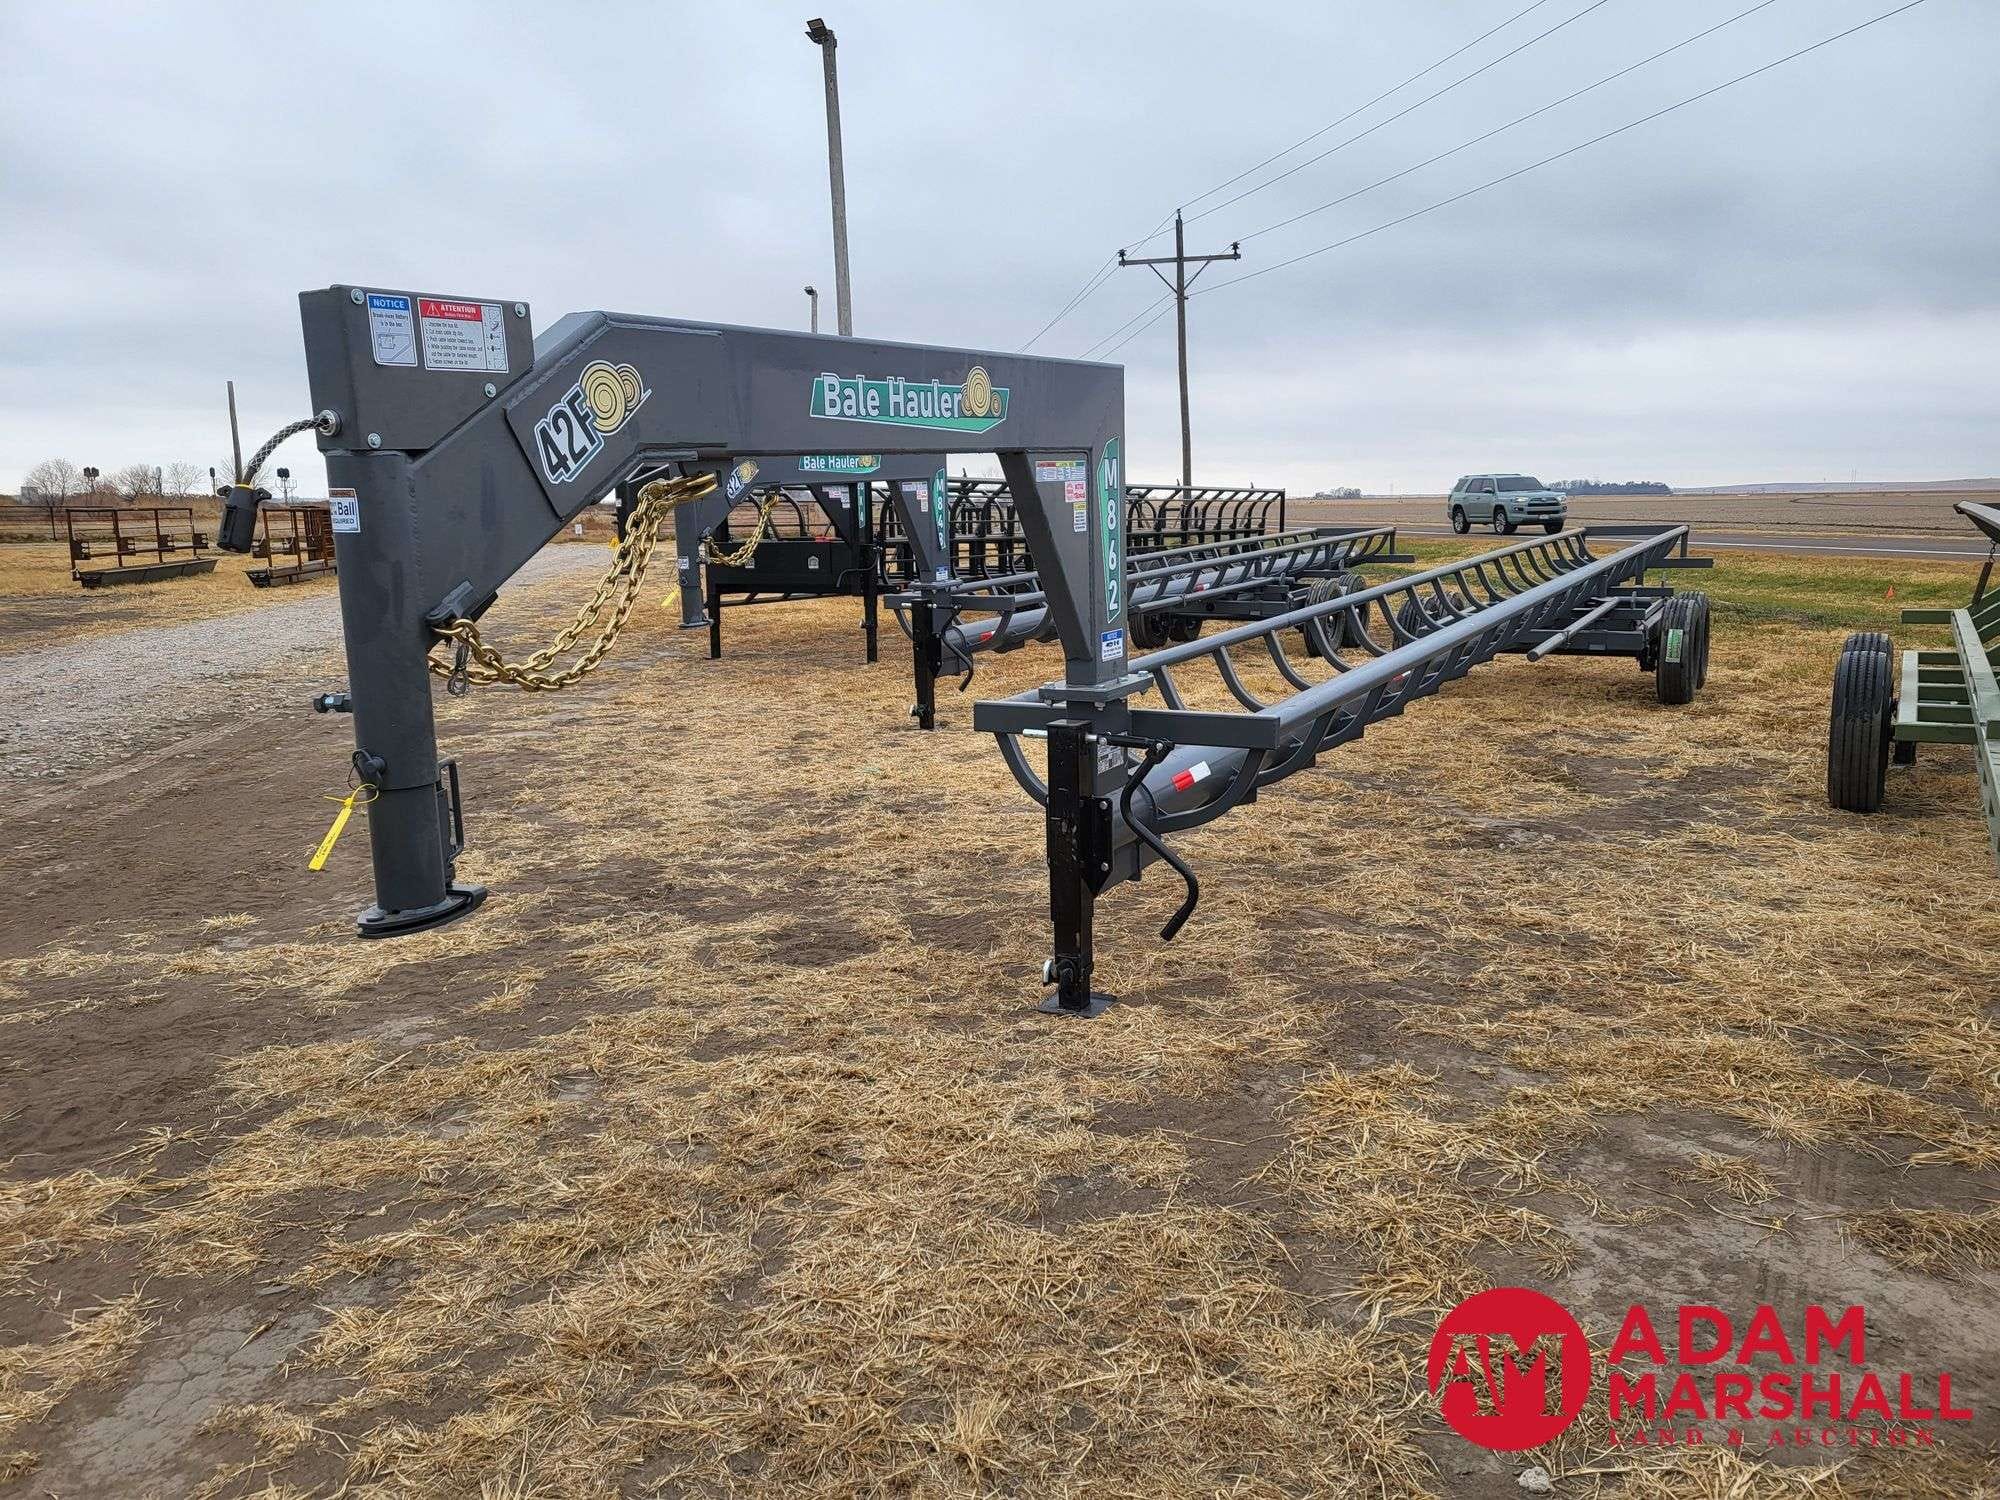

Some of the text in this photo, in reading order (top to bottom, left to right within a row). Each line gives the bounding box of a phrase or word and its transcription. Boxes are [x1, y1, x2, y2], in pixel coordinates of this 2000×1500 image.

[372, 298, 406, 309] NOTICE
[440, 304, 477, 314] ATTENTION
[822, 374, 962, 419] Bale Hauler
[536, 386, 602, 480] 42F
[803, 455, 860, 469] Bale Hauler
[337, 501, 355, 516] Ball
[1104, 458, 1119, 611] M862
